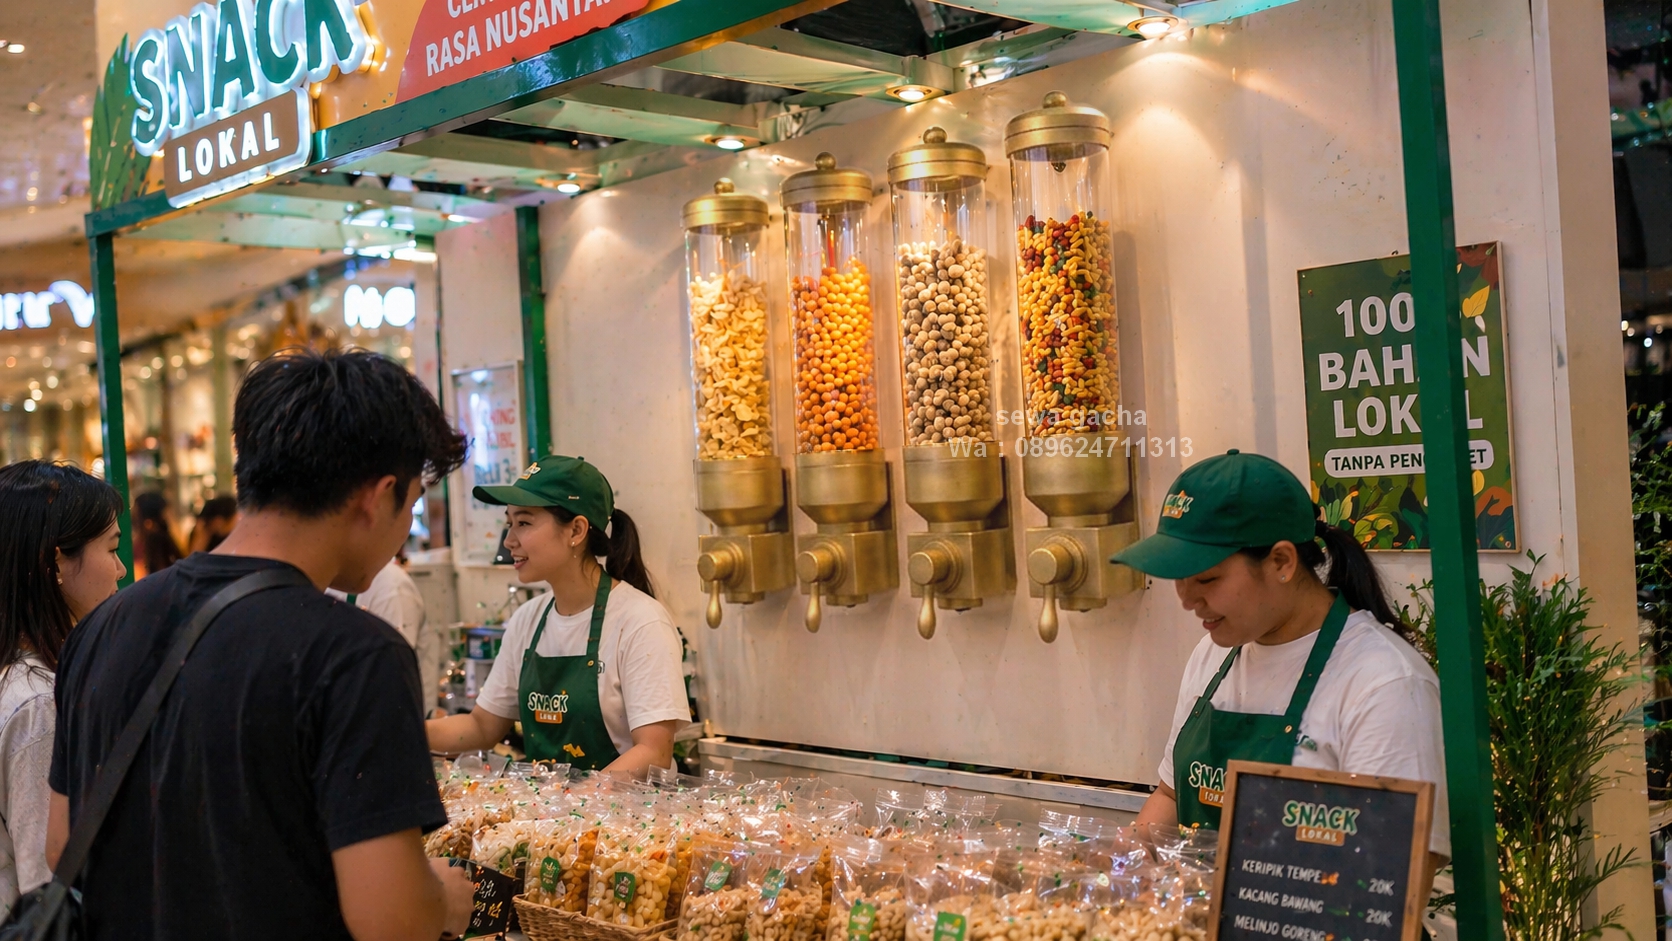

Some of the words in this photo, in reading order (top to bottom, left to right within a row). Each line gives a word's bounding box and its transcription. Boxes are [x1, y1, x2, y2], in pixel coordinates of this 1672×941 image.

[426, 25, 481, 77] RASA
[485, 0, 611, 51] NUSAN
[176, 111, 281, 184] LOKAL
[1335, 292, 1462, 338] 100
[1318, 335, 1491, 392] BAHN
[1333, 389, 1484, 438] LOKL
[1331, 454, 1385, 472] TANPA
[1390, 448, 1487, 469] PENET
[528, 691, 569, 713] SNACK
[1188, 760, 1228, 793] SNA
[1282, 800, 1360, 836] SNACK
[1241, 859, 1284, 878] KERIPIK
[1286, 865, 1322, 884] TEMPE
[1367, 877, 1396, 897] 20K
[1233, 914, 1280, 936] MELINJO
[1238, 886, 1279, 906] KACANG
[1280, 894, 1325, 914] BAWANG
[1365, 908, 1394, 928] 20K
